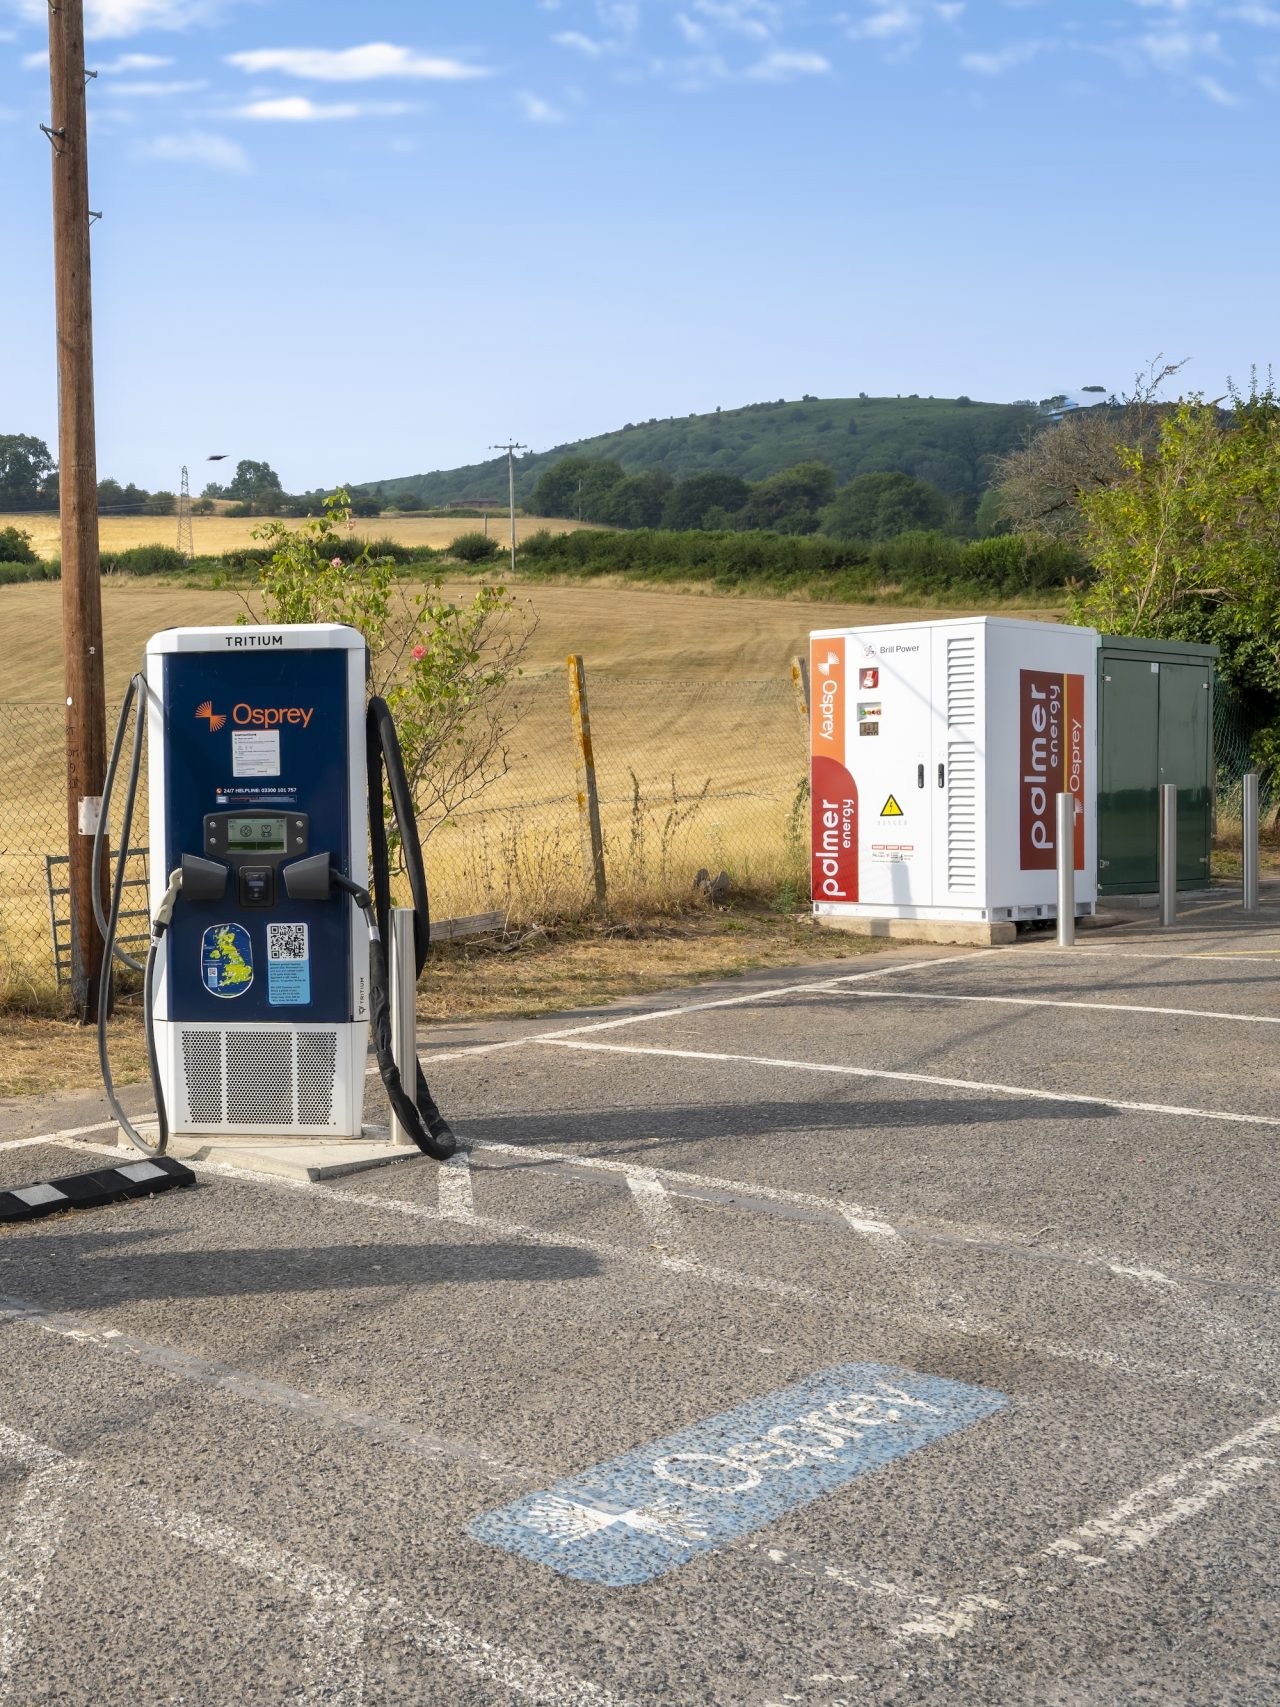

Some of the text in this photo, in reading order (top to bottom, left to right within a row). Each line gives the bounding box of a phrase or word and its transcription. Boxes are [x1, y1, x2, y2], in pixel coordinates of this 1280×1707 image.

[225, 635, 283, 647] TRITIUM
[880, 645, 920, 654] Brill Power
[232, 703, 314, 729] Osprey
[819, 679, 838, 741] Osprey
[1050, 685, 1061, 768] energy
[1024, 683, 1054, 850] palmer
[1069, 718, 1082, 793] Osprey
[815, 799, 847, 897] palmer
[843, 799, 854, 849] energy
[652, 1382, 946, 1494] Osprey
